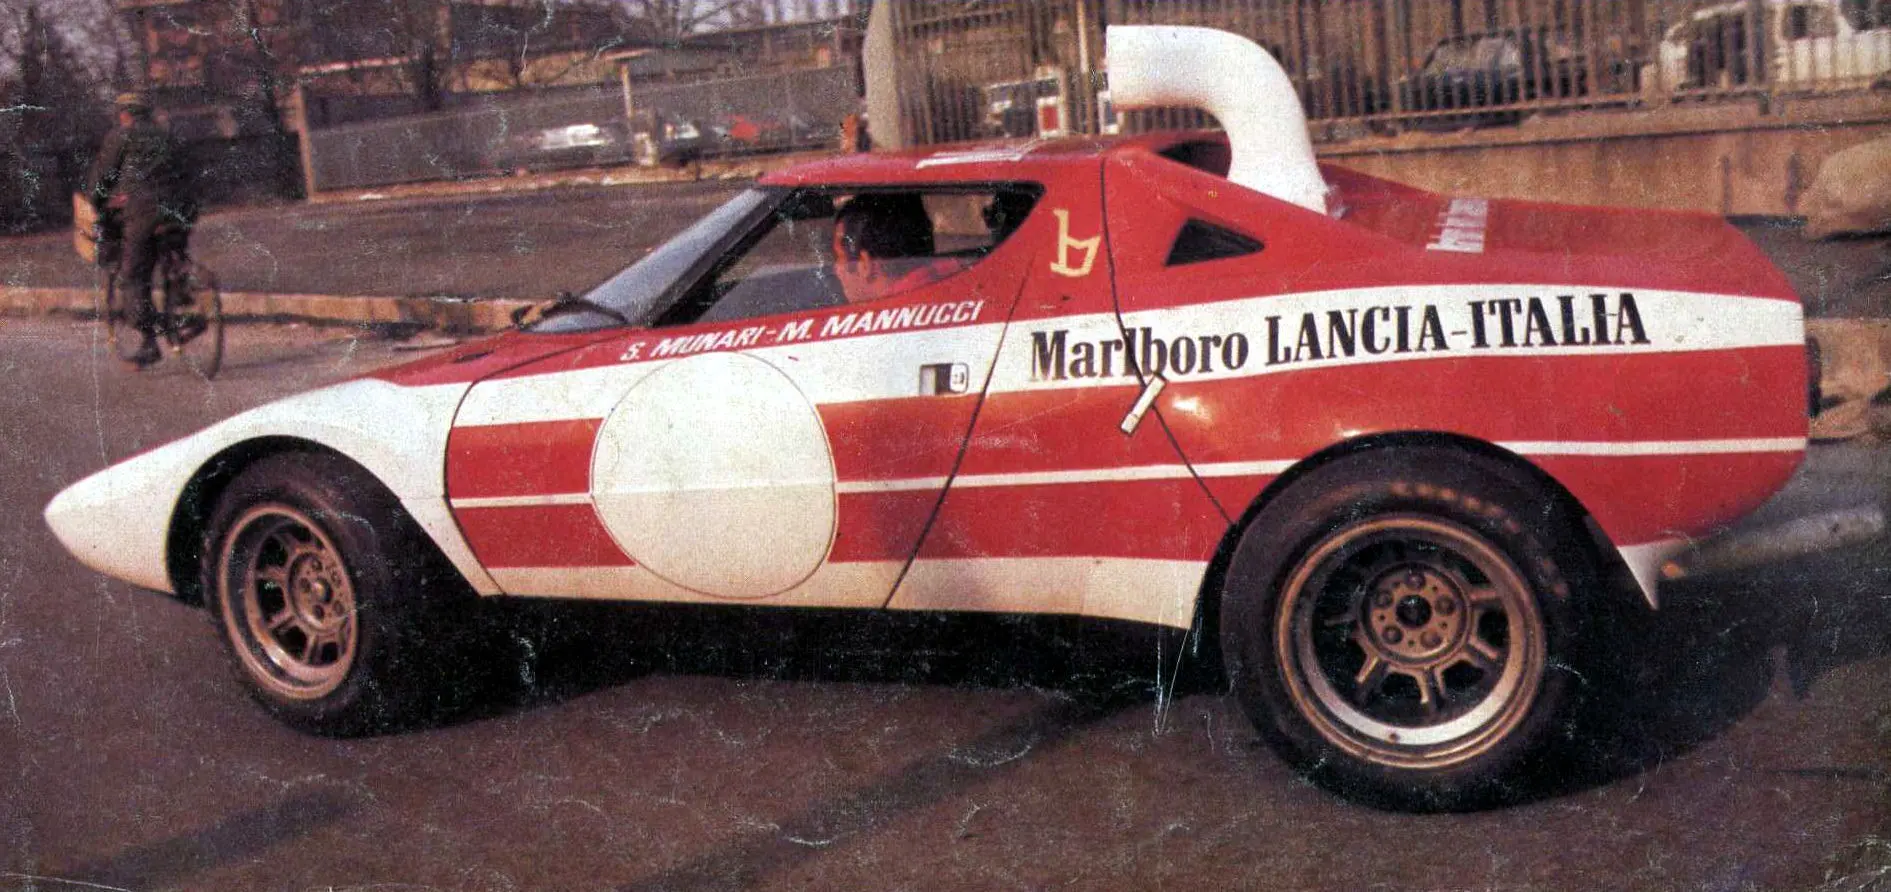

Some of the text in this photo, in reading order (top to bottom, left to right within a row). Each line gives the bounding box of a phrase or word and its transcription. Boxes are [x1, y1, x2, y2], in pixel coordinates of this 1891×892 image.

[620, 342, 646, 361] S.
[820, 300, 985, 338] MANNUCCI
[1031, 327, 1249, 381] Marlboro
